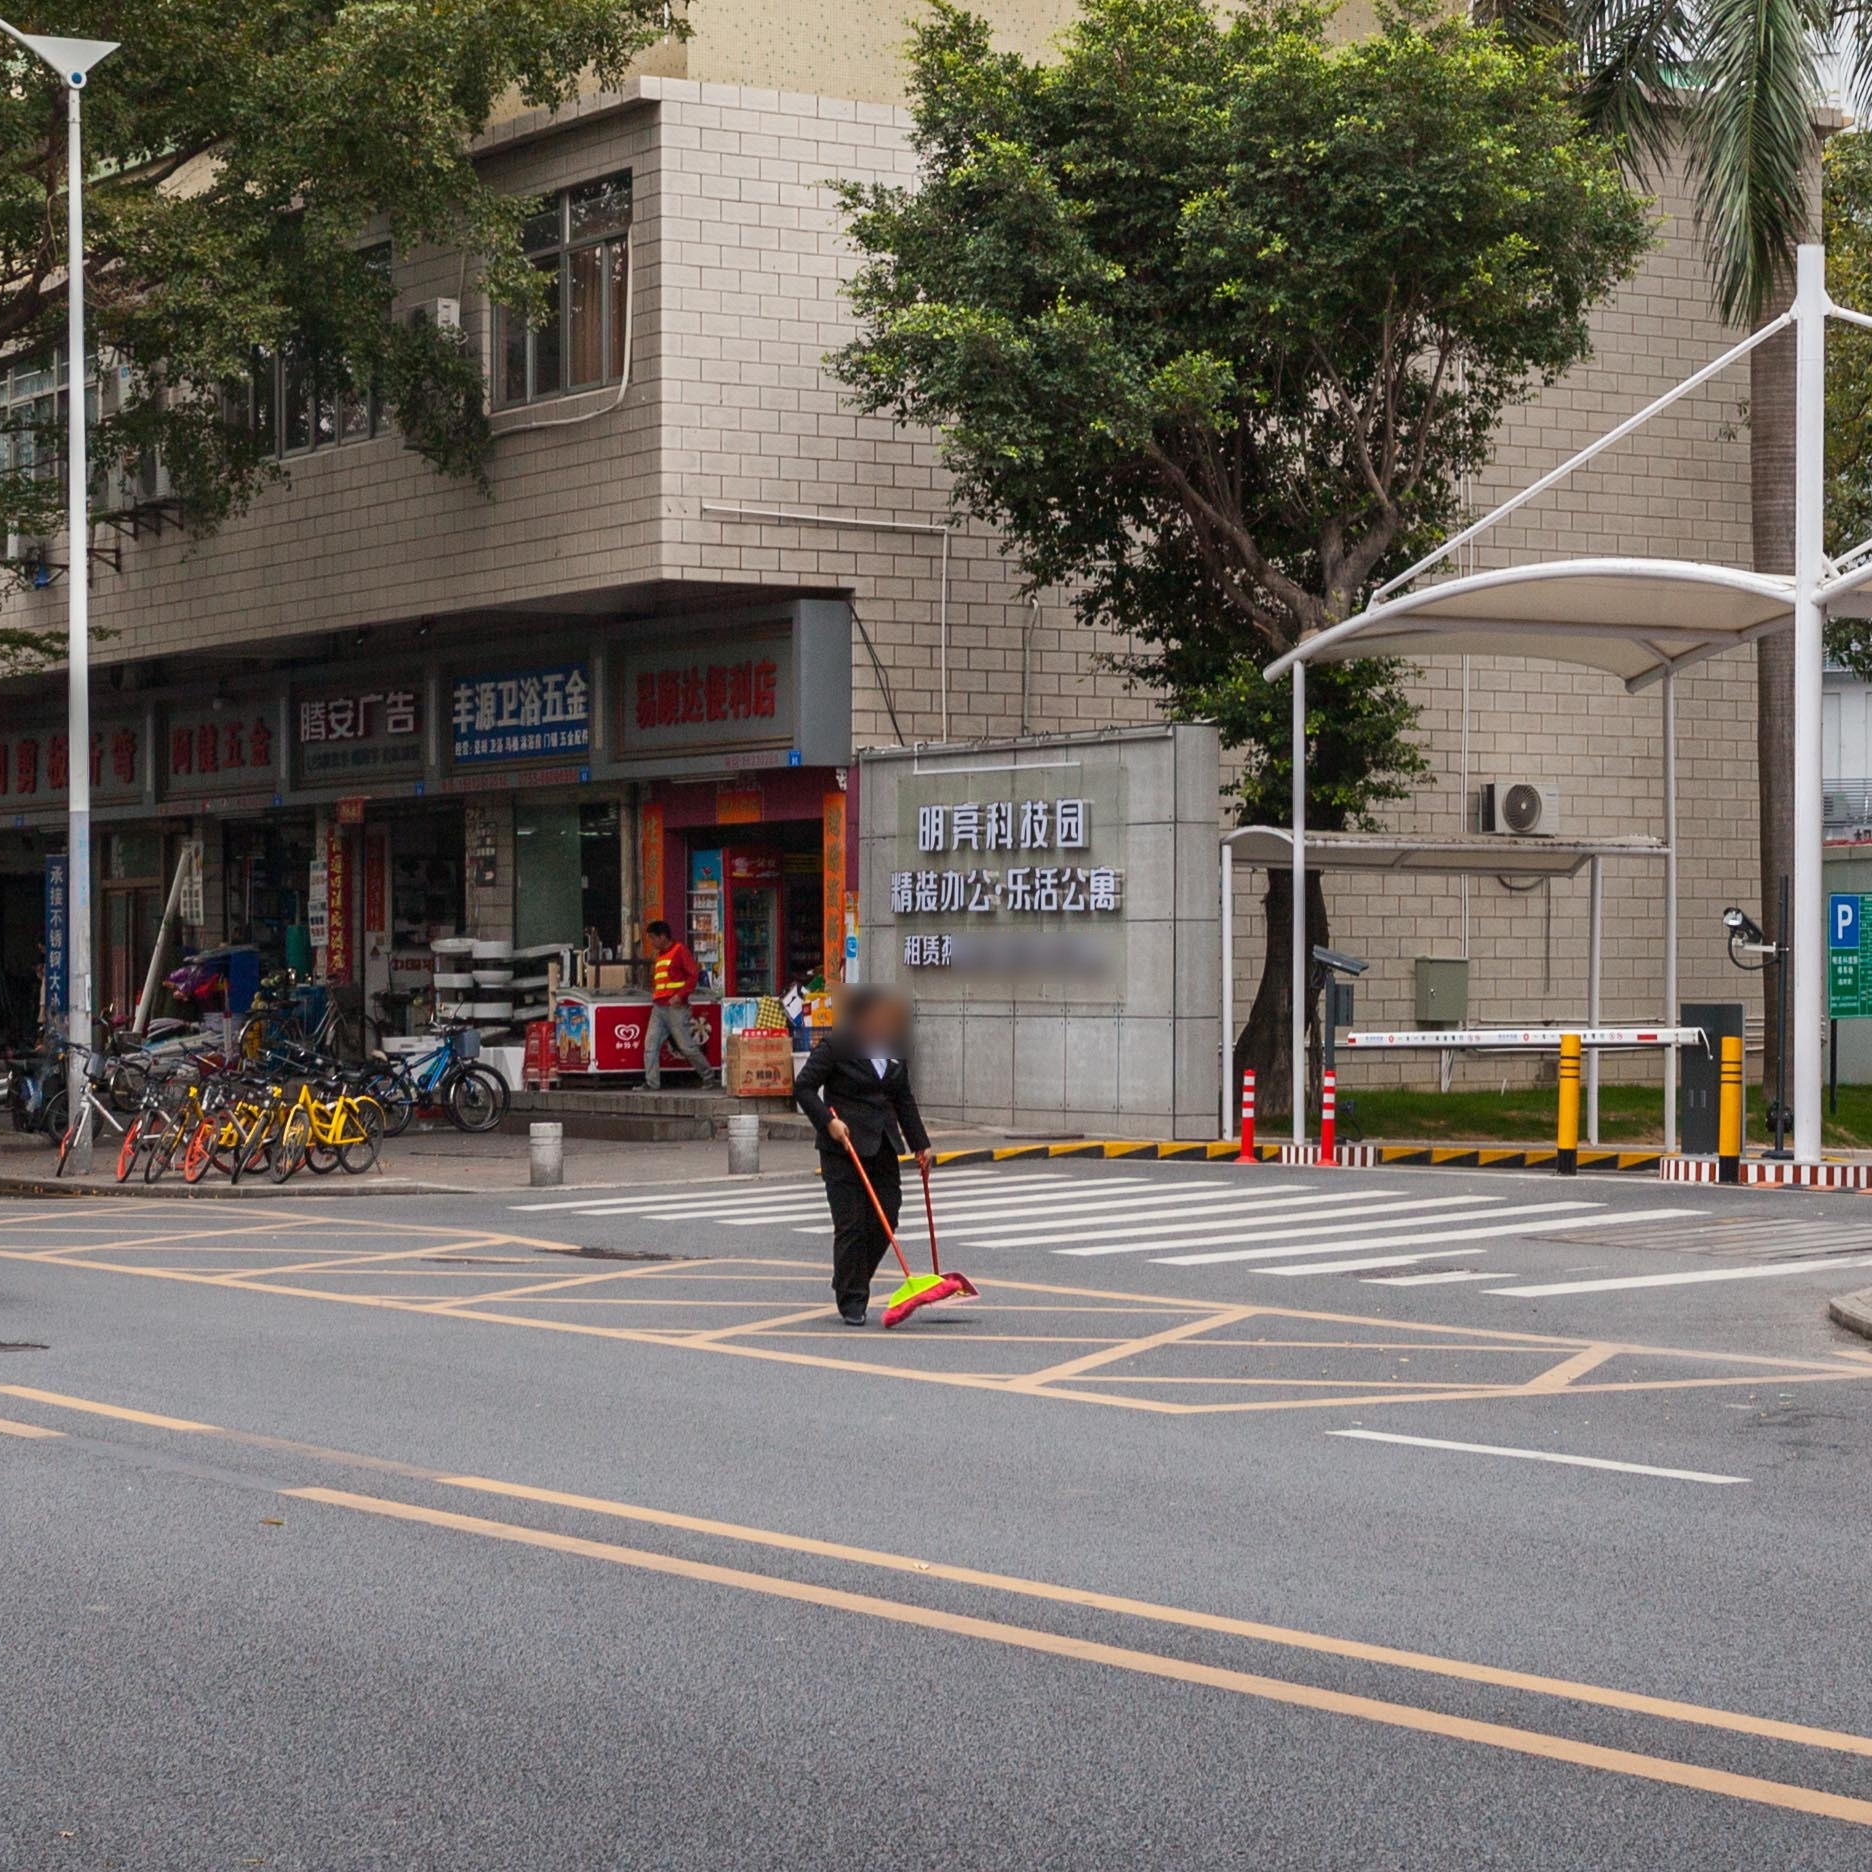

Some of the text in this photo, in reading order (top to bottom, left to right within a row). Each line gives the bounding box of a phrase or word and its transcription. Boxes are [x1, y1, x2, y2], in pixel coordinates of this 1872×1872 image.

[300, 691, 416, 742] 腾安广告
[452, 669, 588, 734] 丰源卫浴五金
[917, 797, 1090, 852] 明亮科技园
[1837, 903, 1854, 940] P
